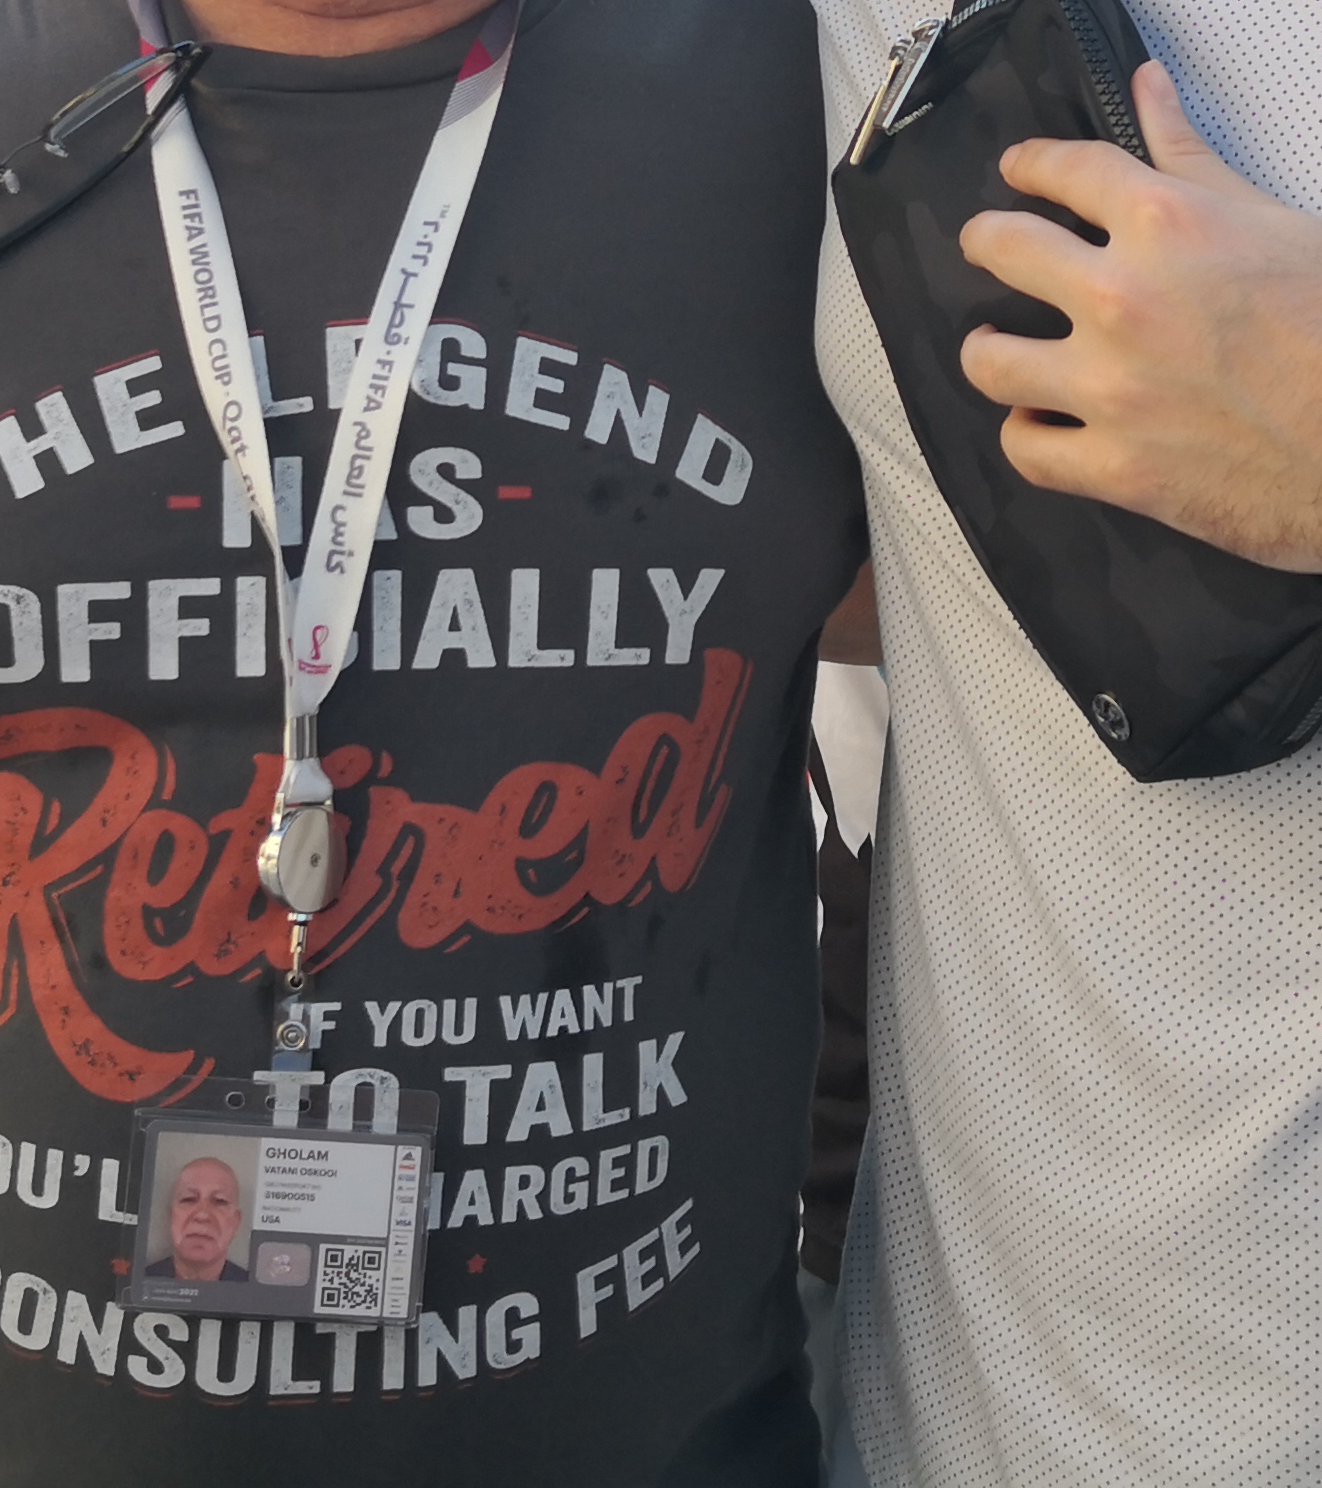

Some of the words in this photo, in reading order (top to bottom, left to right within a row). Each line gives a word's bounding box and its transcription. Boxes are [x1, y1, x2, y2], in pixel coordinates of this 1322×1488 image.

[178, 187, 206, 242] FIFA
[189, 242, 223, 334] WORLD
[208, 338, 233, 387] CUP
[363, 358, 395, 413] FIFA
[222, 446, 484, 549] HS
[365, 997, 477, 1047] YOU
[499, 975, 643, 1041] WANT
[444, 1031, 688, 1145] TALK
[264, 1166, 297, 1176] VATANI
[265, 1147, 330, 1162] GHOLAM
[261, 1215, 281, 1224] USA
[574, 1197, 703, 1338] FEE
